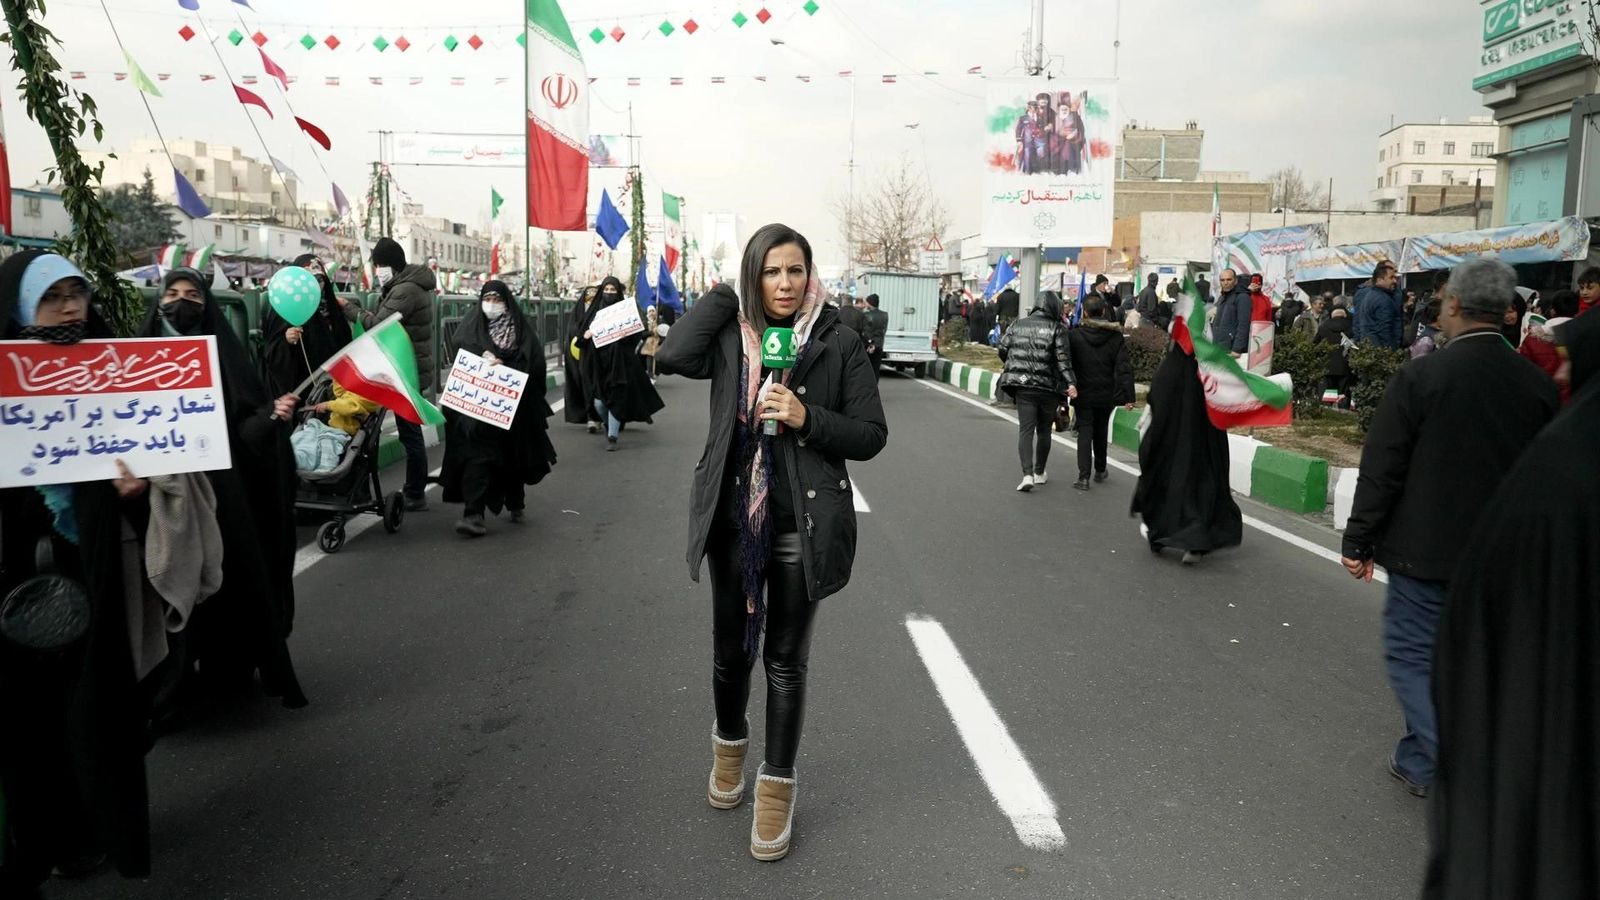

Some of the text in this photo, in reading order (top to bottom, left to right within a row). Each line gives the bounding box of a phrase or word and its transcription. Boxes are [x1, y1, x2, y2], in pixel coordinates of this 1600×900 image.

[991, 189, 1024, 203] کردیم
[1020, 189, 1073, 205] استقبال
[453, 370, 474, 382] DOWN
[474, 377, 495, 391] WITH
[0, 394, 216, 430] شعار مرگ بر آمریکا
[483, 407, 510, 424] ISRAEL
[32, 429, 186, 465] باید حفظ شود
